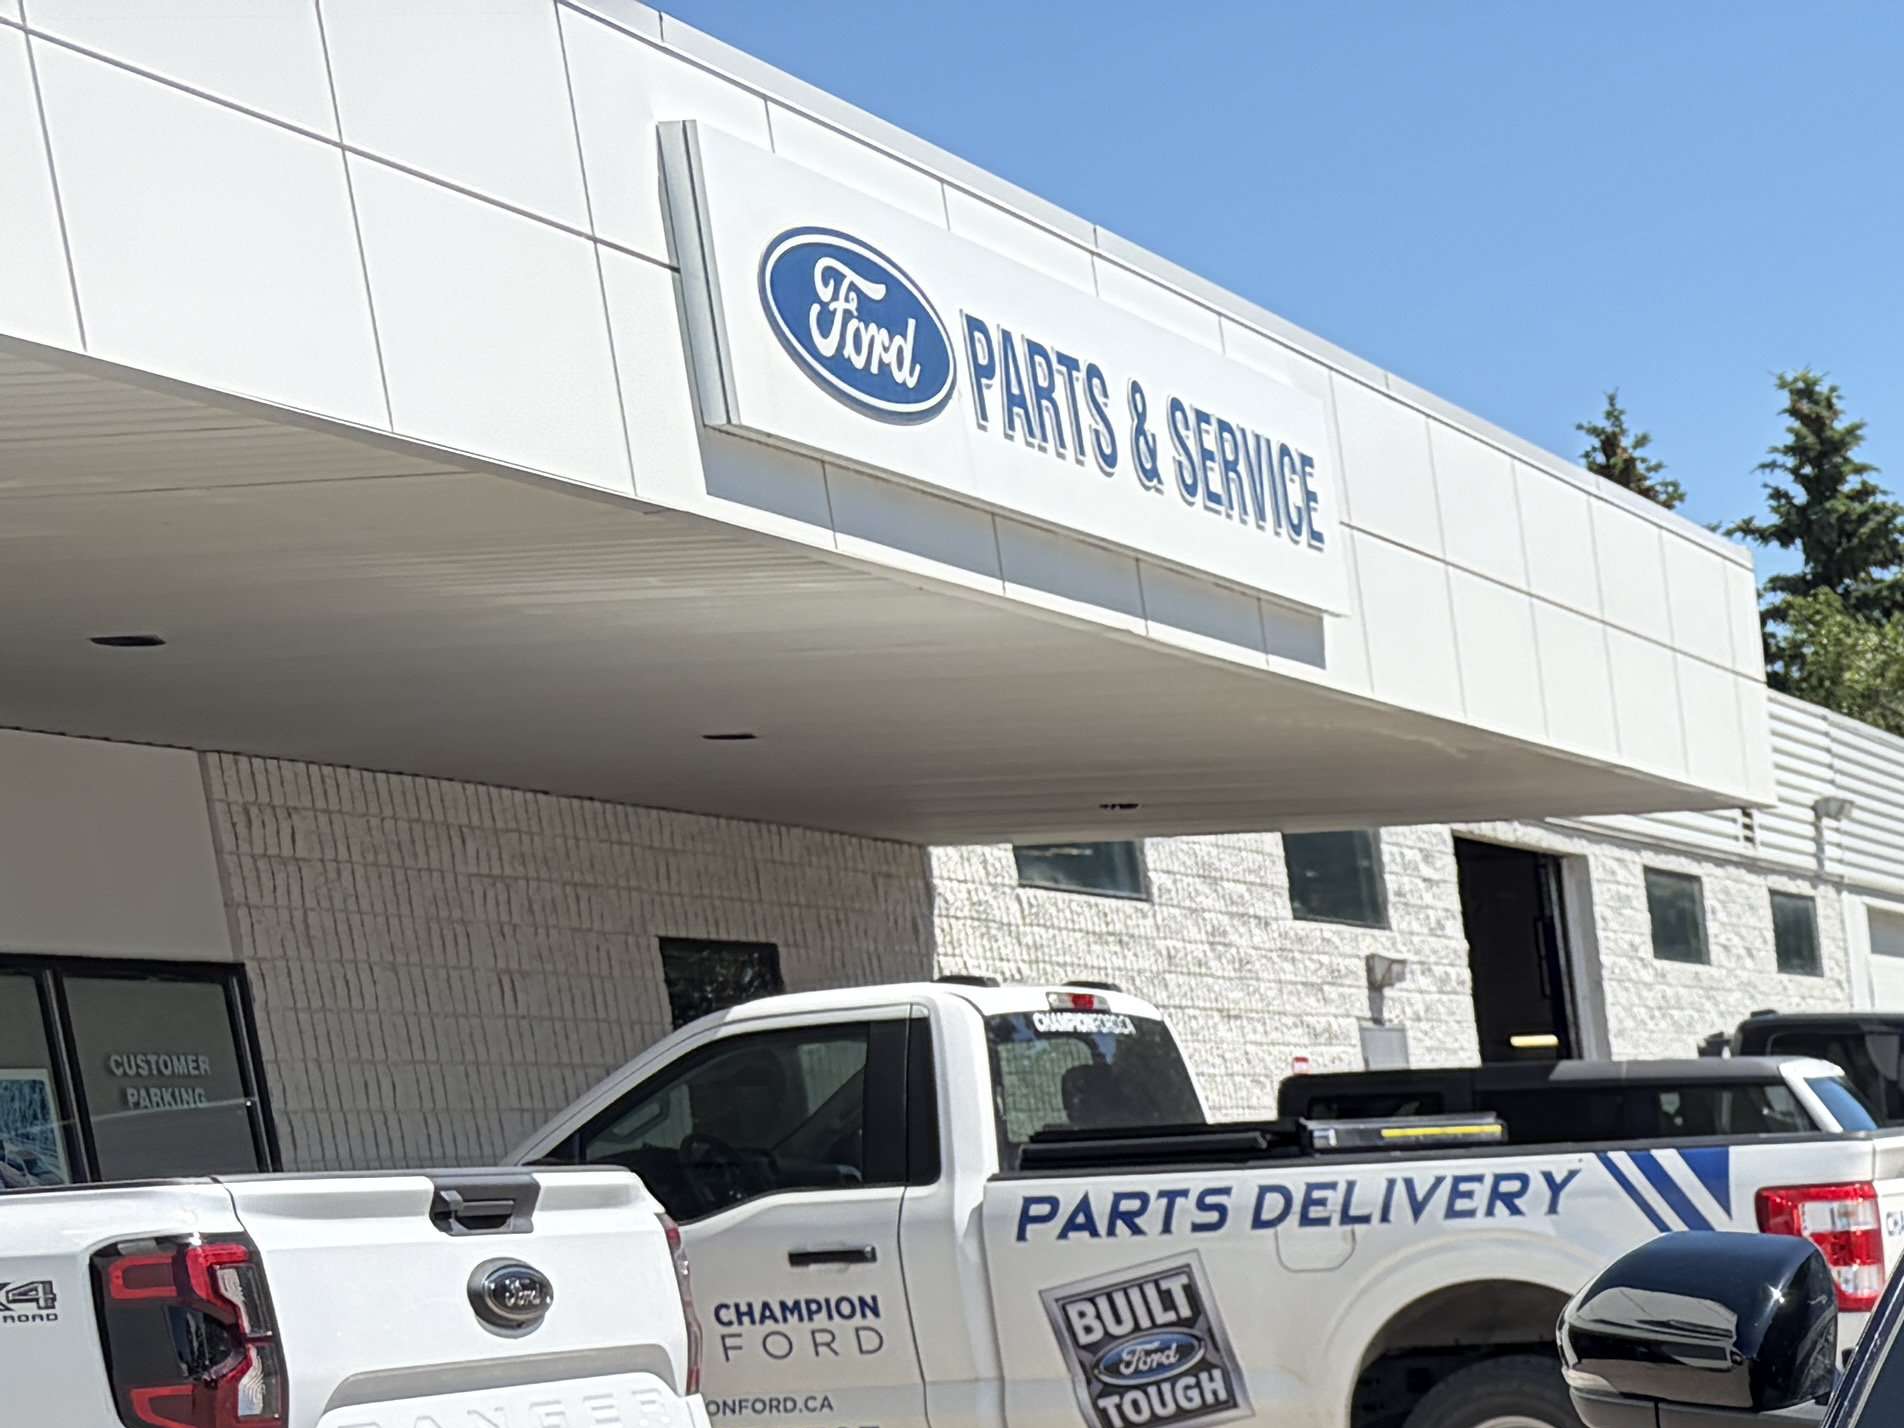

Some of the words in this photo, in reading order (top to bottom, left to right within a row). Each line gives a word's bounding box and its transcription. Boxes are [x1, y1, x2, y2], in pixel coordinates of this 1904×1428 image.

[809, 256, 921, 389] Ford
[961, 309, 1118, 476] PARTS
[1127, 378, 1163, 492] &
[1168, 395, 1324, 550] SERVICE
[109, 1054, 211, 1077] CUSTOMER
[126, 1087, 209, 1110] PARKING
[1015, 1186, 1232, 1242] PARTS
[1250, 1168, 1582, 1230] DELIVERY
[714, 1295, 880, 1327] CHAMPION
[1065, 1273, 1192, 1346] BUILT
[720, 1326, 884, 1363] FORD
[1119, 1340, 1180, 1376] Ford
[1097, 1368, 1229, 1428] TOUGH
